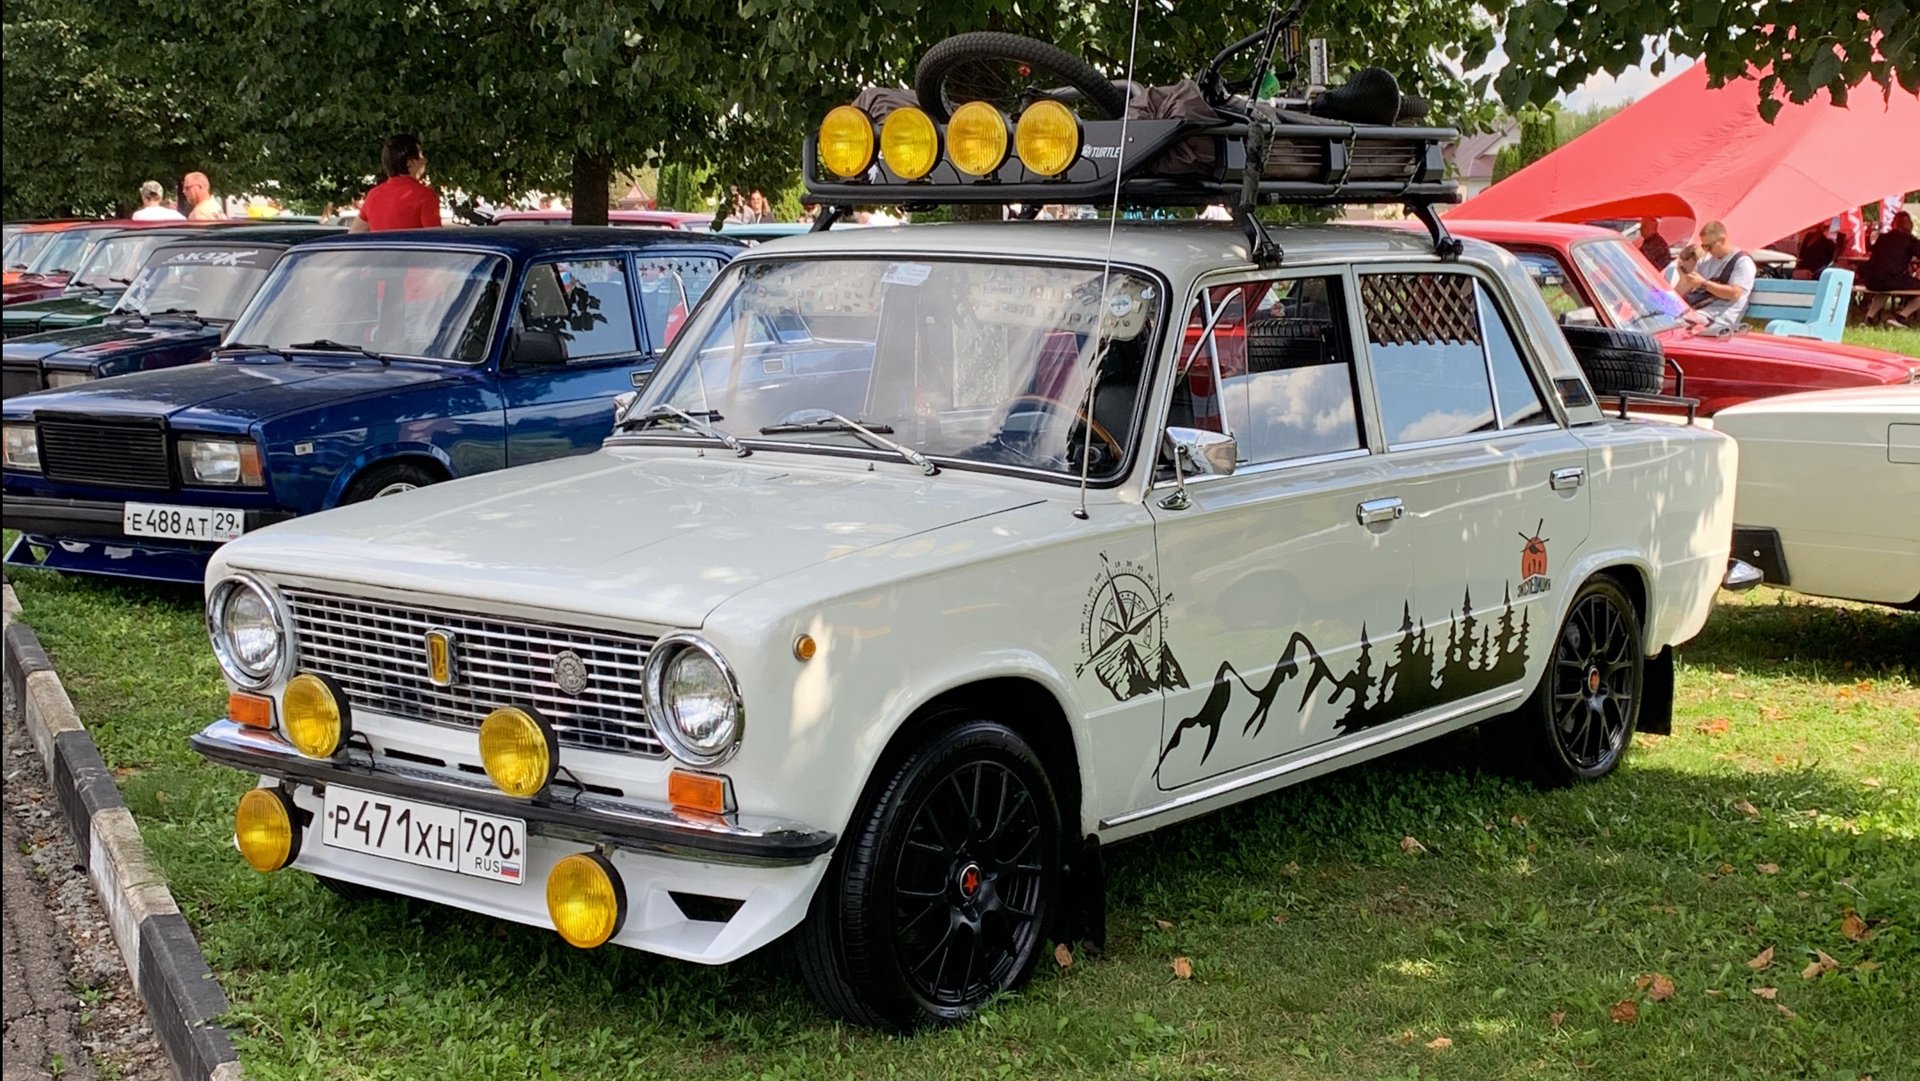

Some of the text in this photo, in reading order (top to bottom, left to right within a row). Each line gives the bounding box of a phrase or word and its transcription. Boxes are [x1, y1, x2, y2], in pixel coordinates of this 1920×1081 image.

[1091, 146, 1121, 158] TURTLE
[132, 509, 235, 536] Е488АТ 29
[334, 801, 514, 863] Р471ХН 790
[475, 856, 500, 873] RUS
